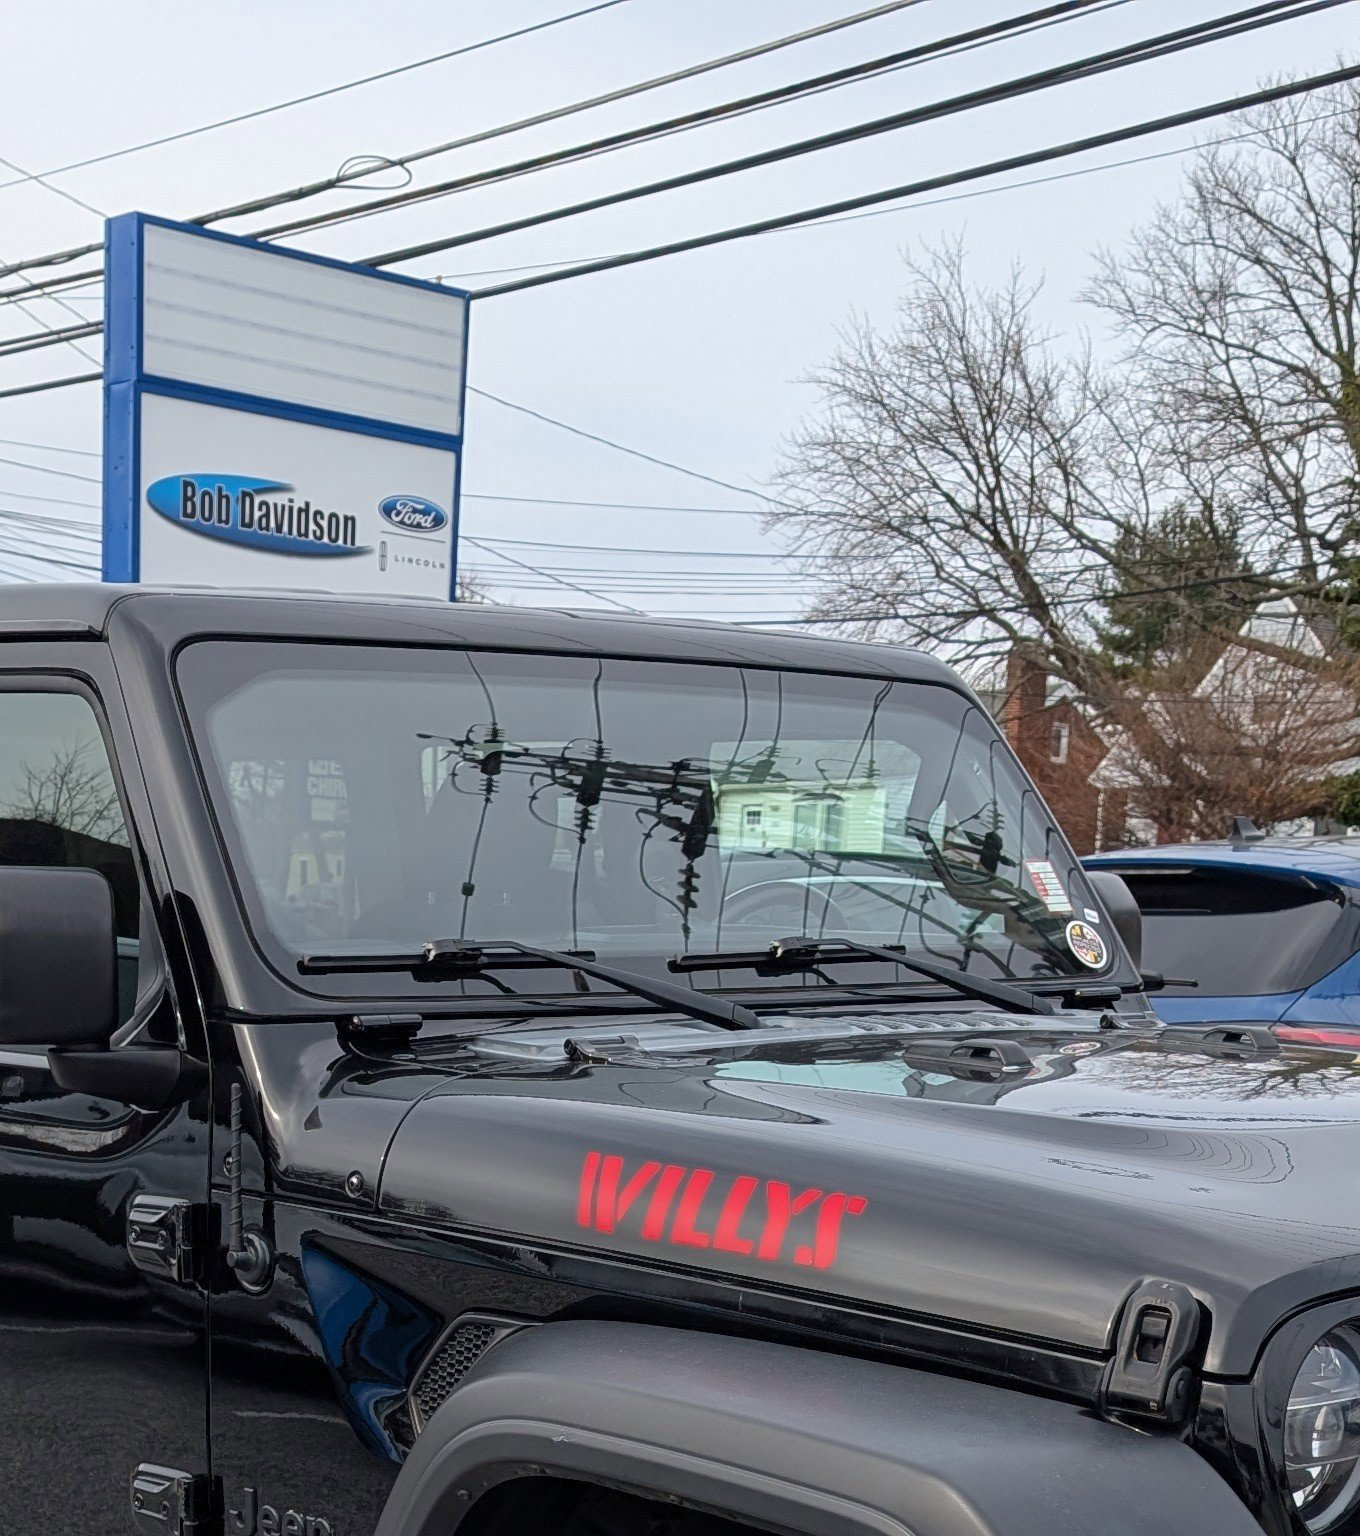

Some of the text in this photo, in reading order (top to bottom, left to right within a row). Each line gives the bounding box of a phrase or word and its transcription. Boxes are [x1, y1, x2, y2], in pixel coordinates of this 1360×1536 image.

[181, 478, 357, 547] Bob Davidson
[391, 500, 437, 528] Ford
[393, 555, 446, 569] LINCOLN
[577, 1151, 868, 1271] WILLYS
